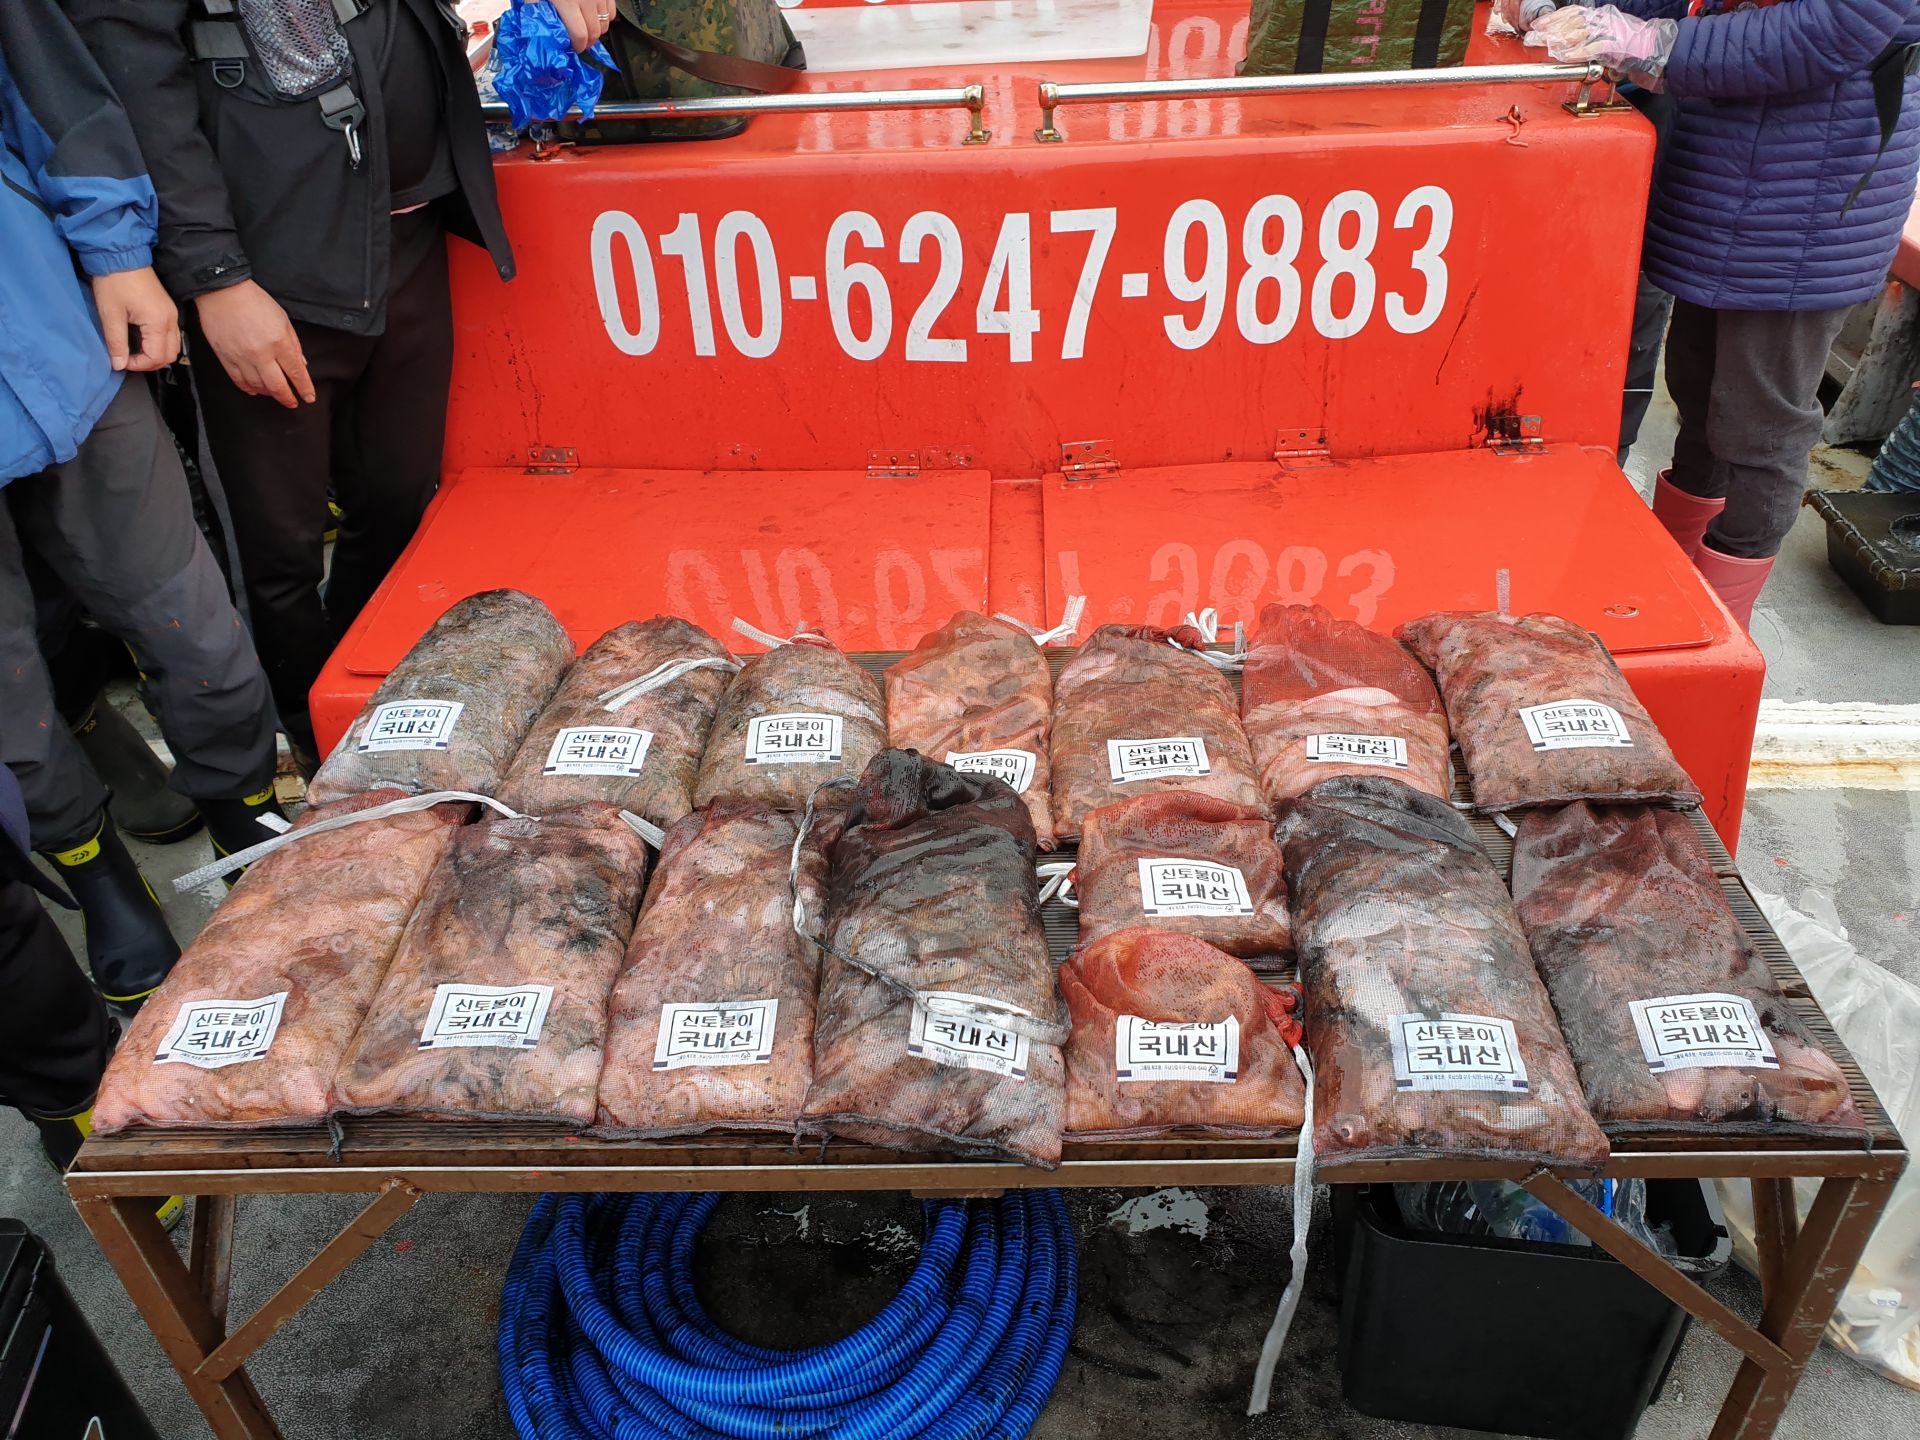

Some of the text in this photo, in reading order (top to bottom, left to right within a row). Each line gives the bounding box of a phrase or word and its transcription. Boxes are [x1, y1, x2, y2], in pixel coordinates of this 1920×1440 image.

[591, 186, 1453, 362] 010-6247-9883
[380, 721, 437, 735] 국내산
[1545, 720, 1610, 733] 국내산
[764, 734, 825, 748] 국내산
[1326, 742, 1390, 755] 국내산
[567, 746, 629, 760] 국내산
[1129, 754, 1190, 767] 국내산
[1161, 868, 1226, 884] 신토불이
[1162, 883, 1230, 901] 국내산
[455, 996, 527, 1013] 신토불이
[195, 1010, 266, 1028] 신토불이
[448, 1011, 523, 1029] 국내산
[682, 1013, 754, 1028] 신토불이
[1659, 1006, 1739, 1024] 신토불이
[187, 1028, 260, 1050] 국내산
[677, 1030, 754, 1048] 국내산
[934, 1020, 1009, 1052] 국내산
[1415, 1025, 1495, 1042] 신토불이
[1663, 1025, 1749, 1045] 국내산
[1138, 1035, 1218, 1057] 국내산
[1416, 1044, 1502, 1066] 국내산
